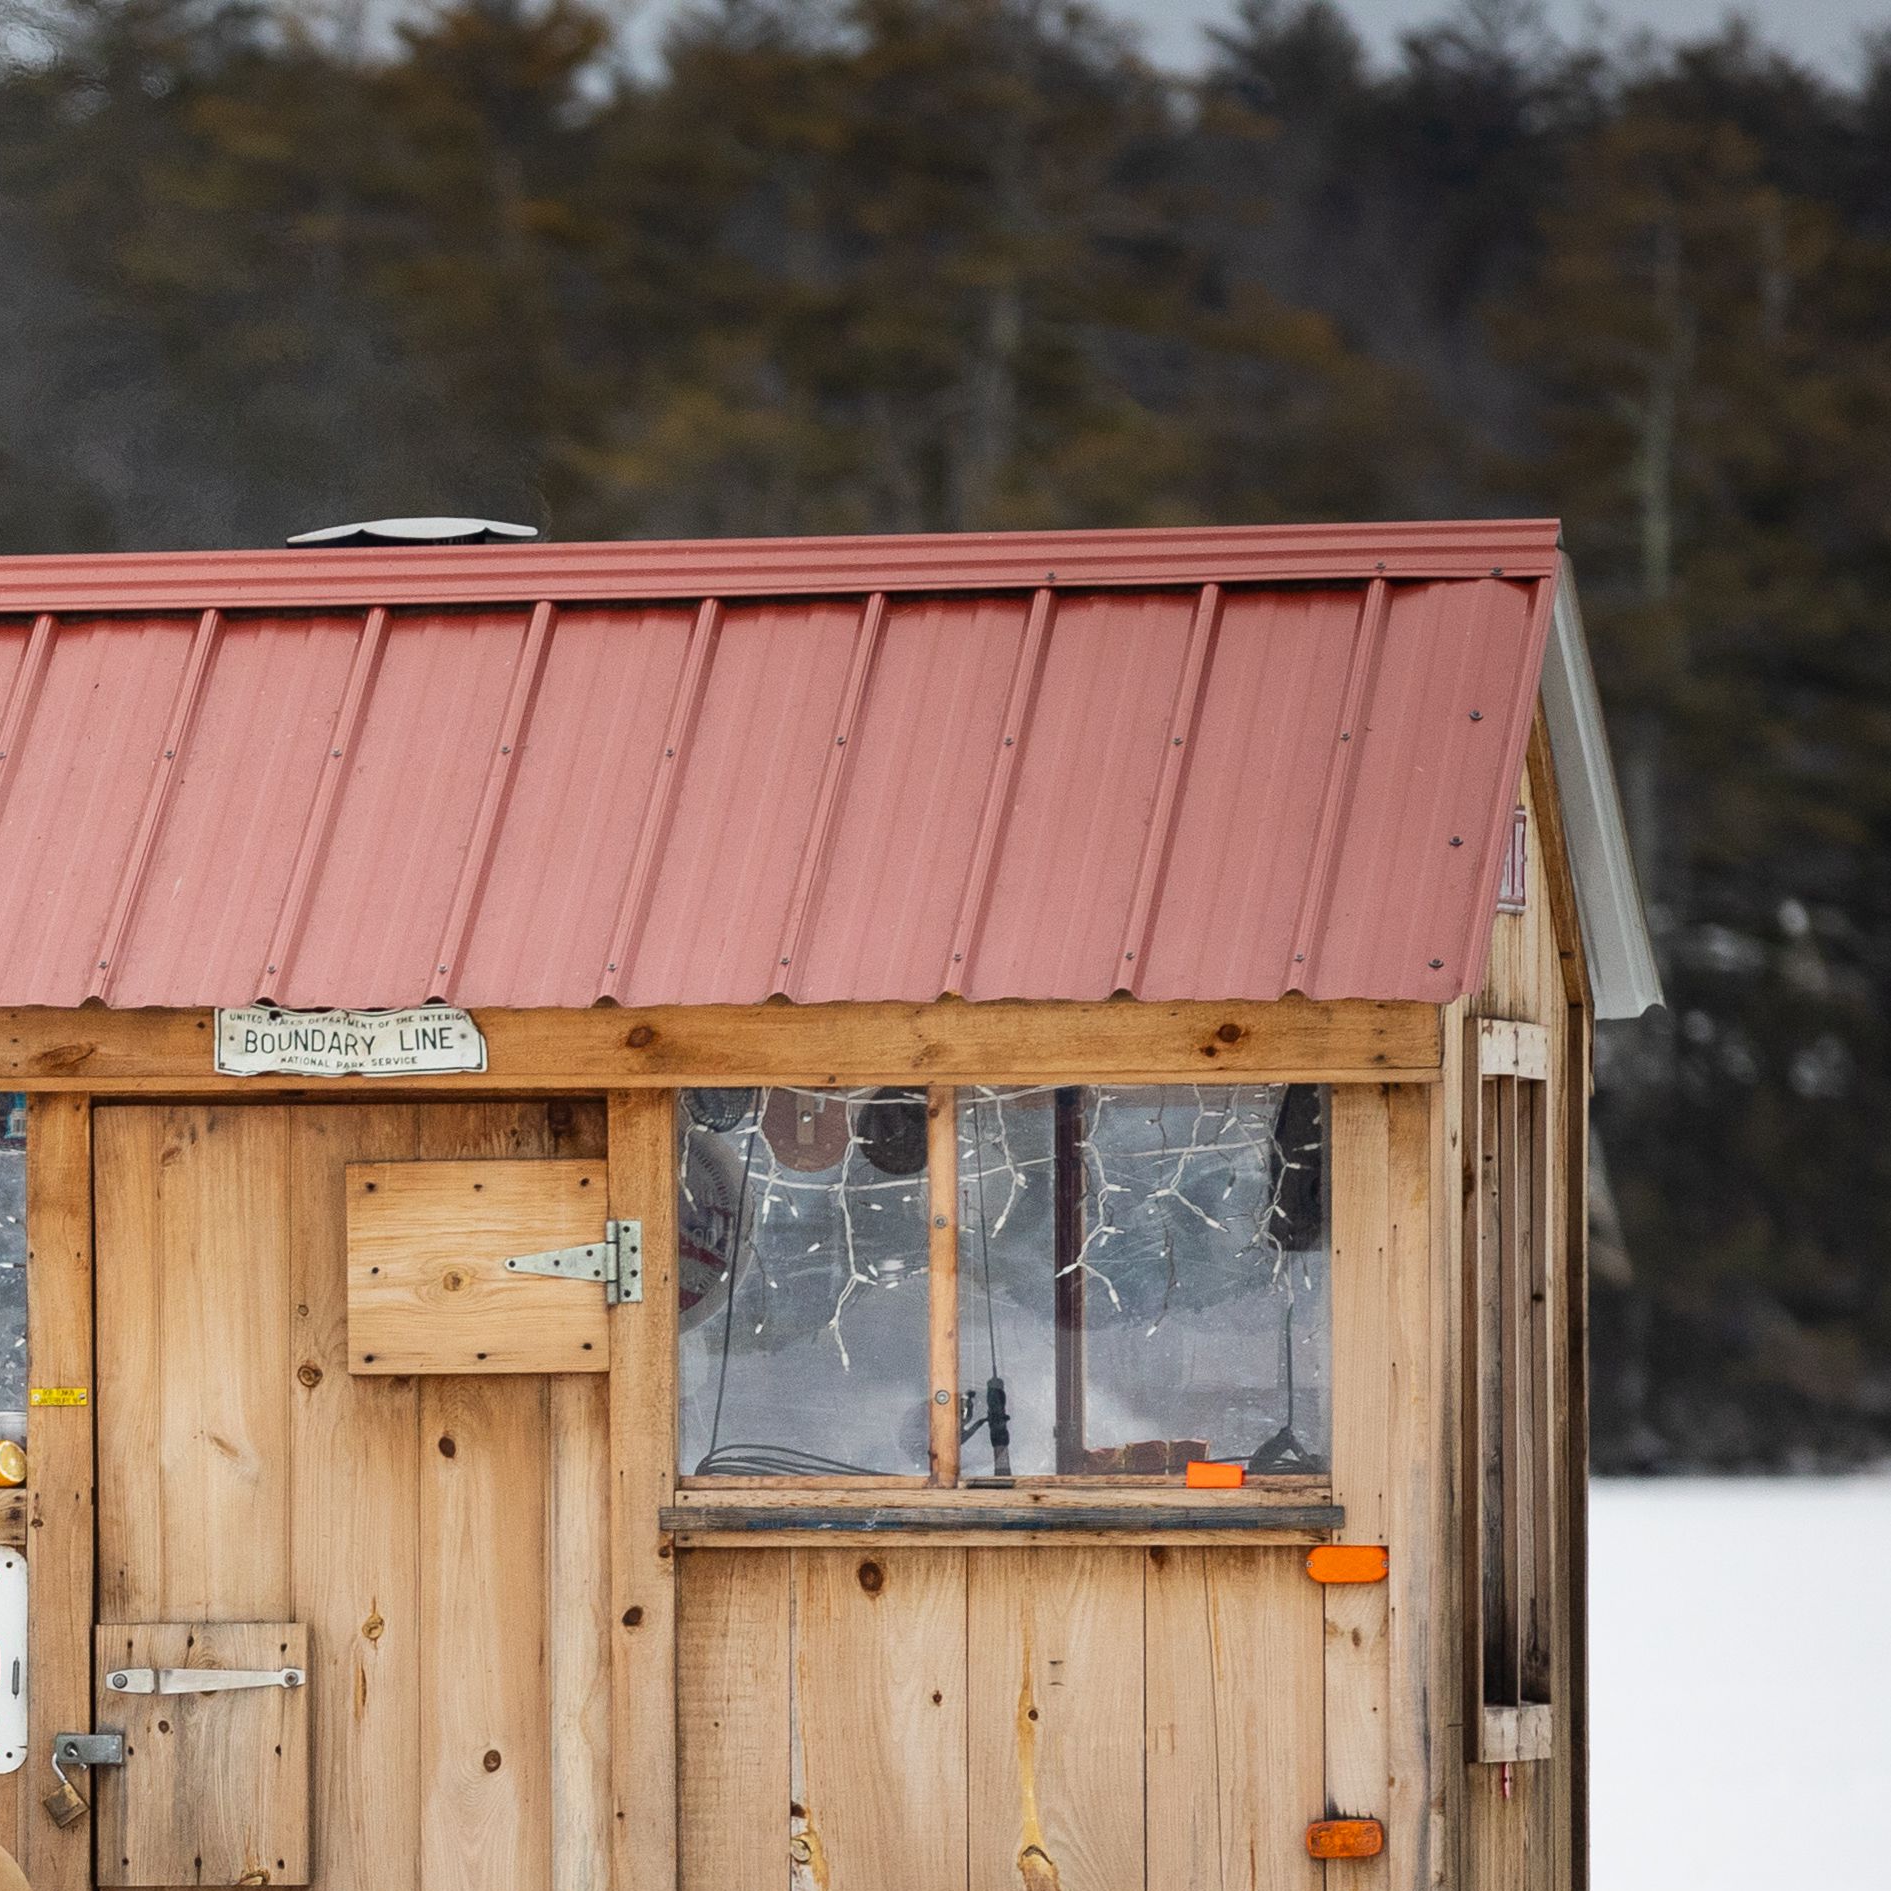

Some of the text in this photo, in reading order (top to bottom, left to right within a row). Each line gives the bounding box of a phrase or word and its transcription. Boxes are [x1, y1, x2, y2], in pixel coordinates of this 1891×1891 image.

[229, 1013, 263, 1025] UNITED
[378, 1018, 390, 1029] OF
[396, 1014, 415, 1025] THE
[244, 1026, 454, 1057] BOUNDARY LINE
[279, 1055, 419, 1070] NATIONAL PARK SERVICE
